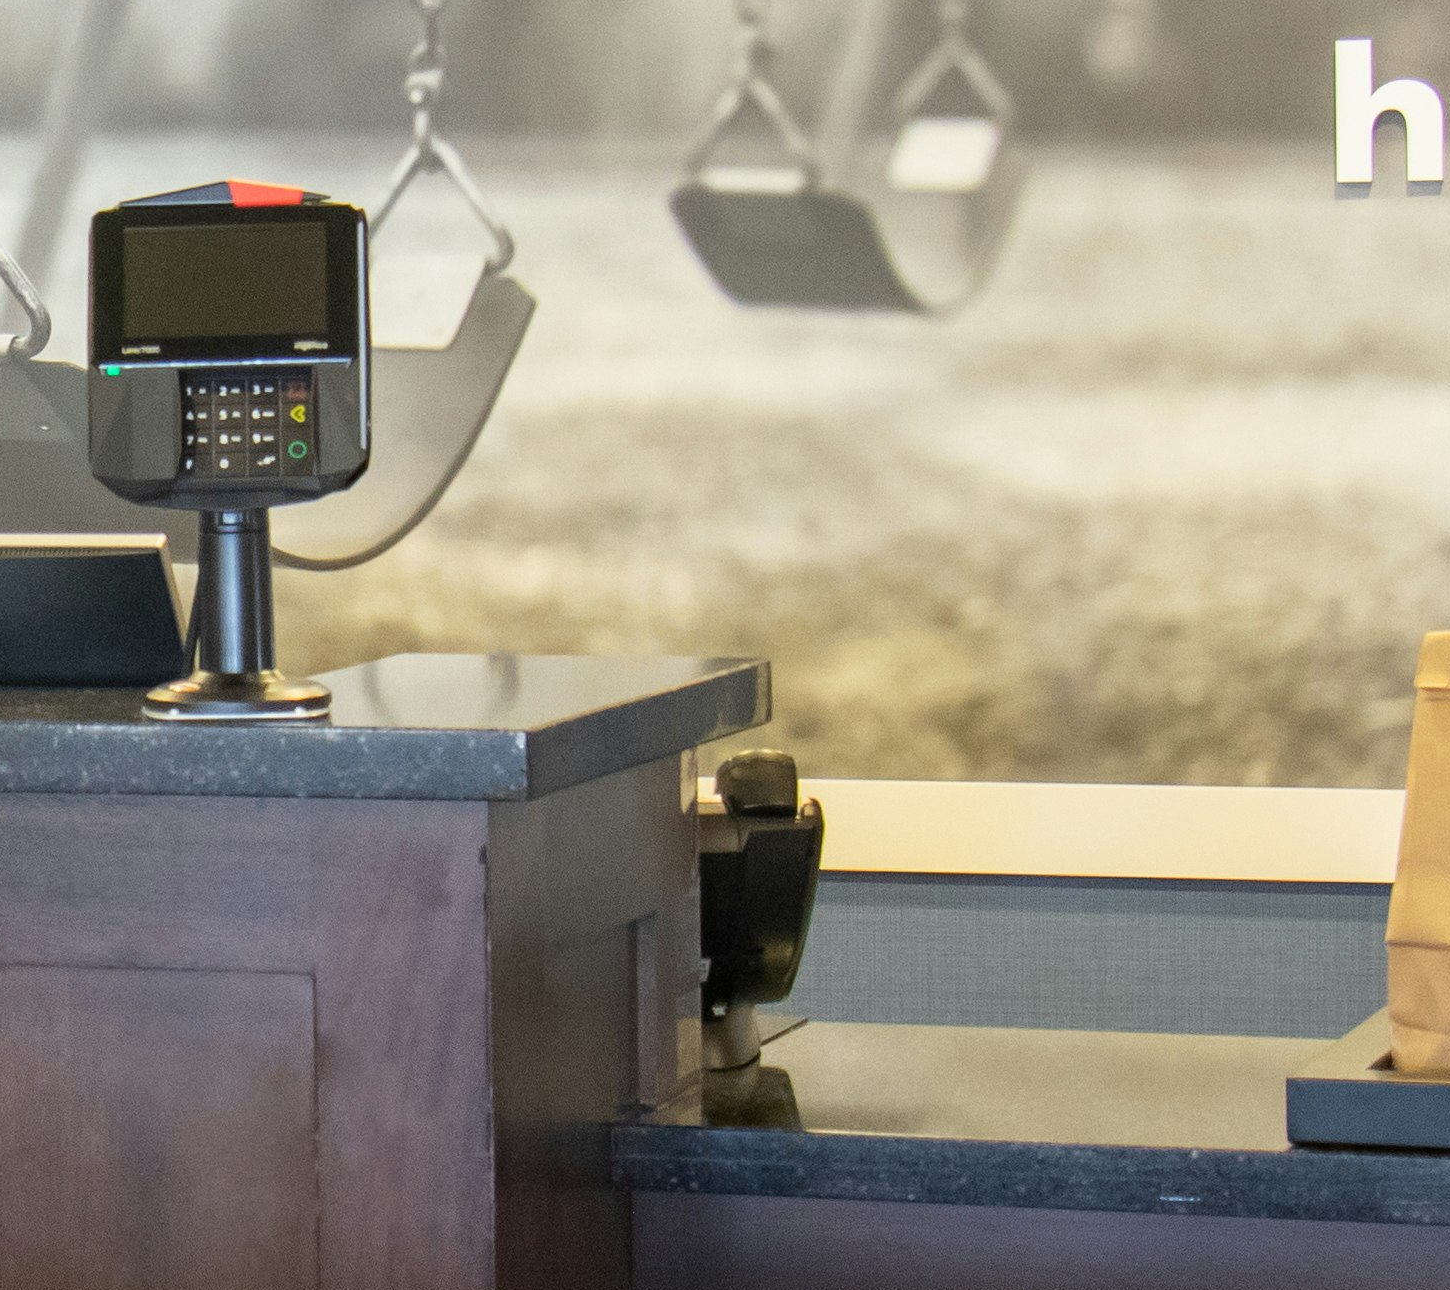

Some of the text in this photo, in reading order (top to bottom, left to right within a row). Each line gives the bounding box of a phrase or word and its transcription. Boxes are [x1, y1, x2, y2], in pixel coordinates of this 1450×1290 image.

[185, 386, 192, 396] 1
[219, 386, 227, 397] 2
[186, 435, 194, 445] 7
